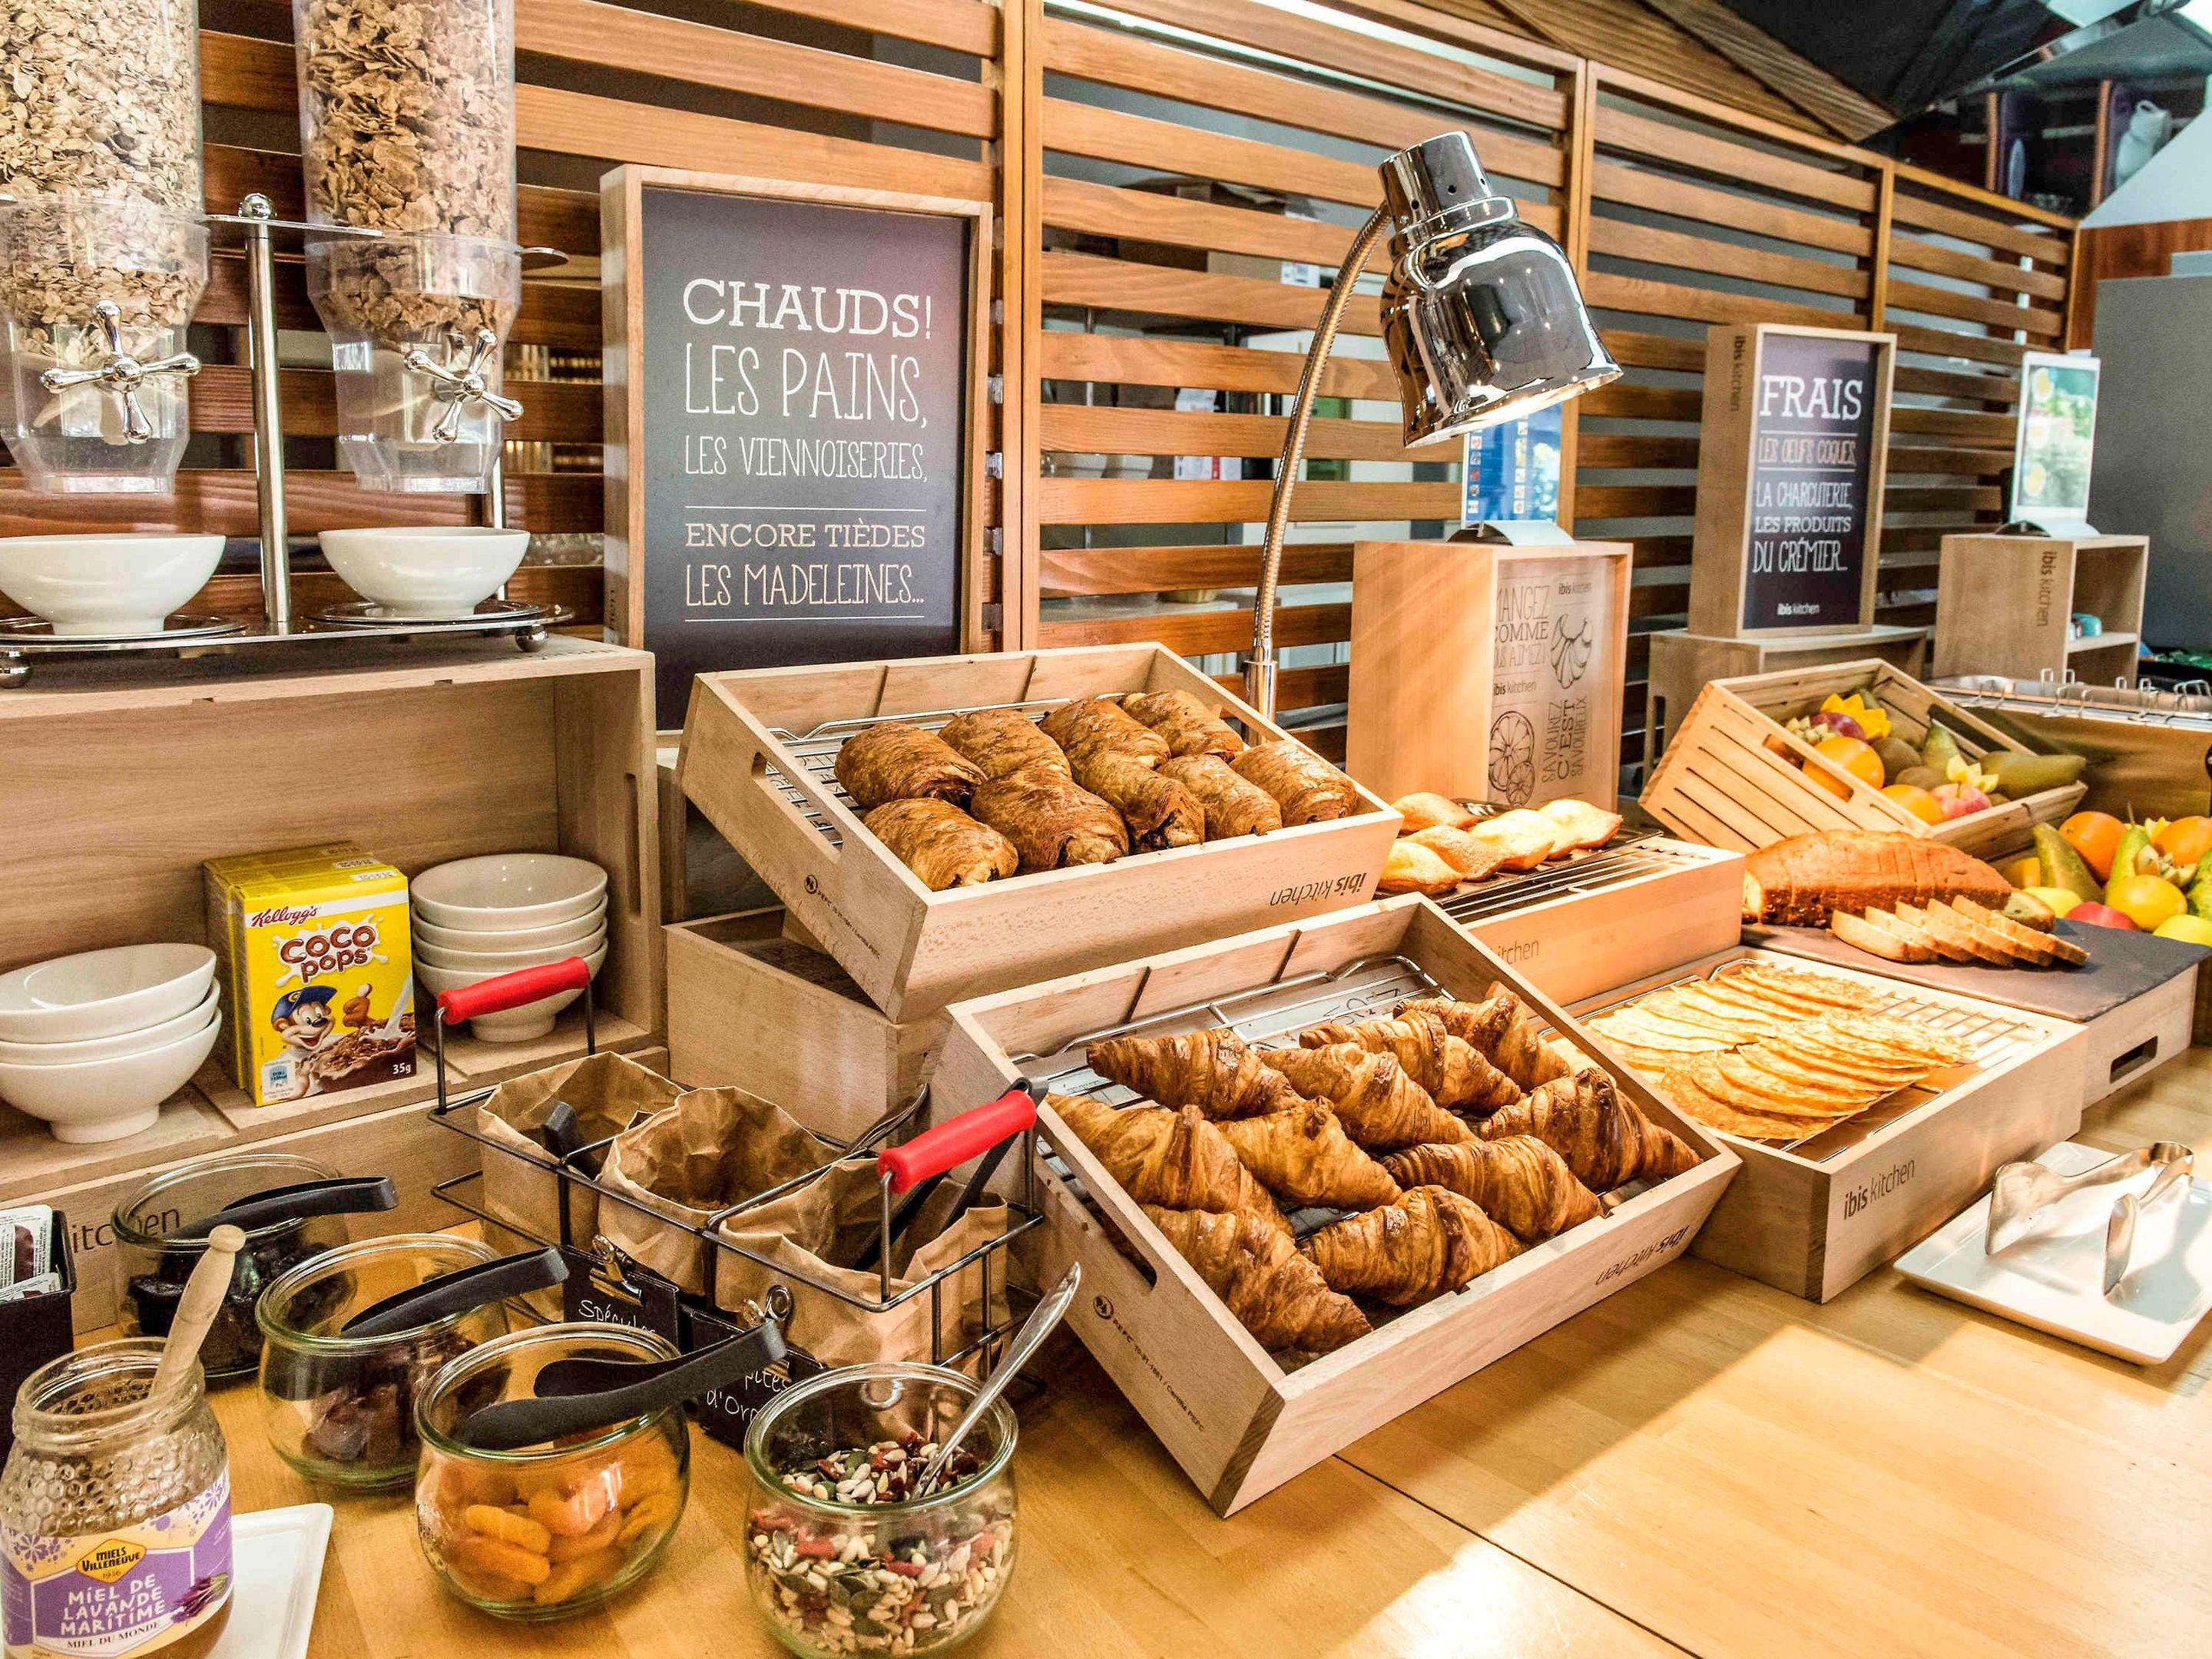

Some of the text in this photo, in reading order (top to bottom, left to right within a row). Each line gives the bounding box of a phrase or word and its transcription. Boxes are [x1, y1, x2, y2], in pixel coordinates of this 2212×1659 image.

[683, 278, 932, 339] CHAUDS!
[684, 343, 927, 429] LES PAINS,
[1760, 375, 1863, 421] FRAIS
[684, 435, 928, 483] LES VIENNOISERIES,
[1758, 438, 1779, 463] LES
[1756, 482, 1773, 508] LA
[685, 518, 926, 548] ENCORE TIÈDES
[1754, 516, 1852, 533] LES PRODUITS
[1752, 540, 1774, 573] DU
[2040, 551, 2058, 575] ibis
[685, 564, 924, 607] LES MADELEINES...
[1495, 621, 1549, 644] OMME
[1557, 700, 1575, 780] C'EST
[1270, 873, 1367, 906] ibis kitchen
[251, 905, 320, 928] Kellogg's
[300, 948, 369, 984] pops
[1490, 939, 1540, 965] itchen
[392, 1063, 412, 1075] 35g
[1843, 1159, 1916, 1220] ibis kitchen
[130, 1574, 156, 1594] DE
[63, 1587, 163, 1621] LAVANDE
[67, 1621, 160, 1649] MIEL DU MONDE
